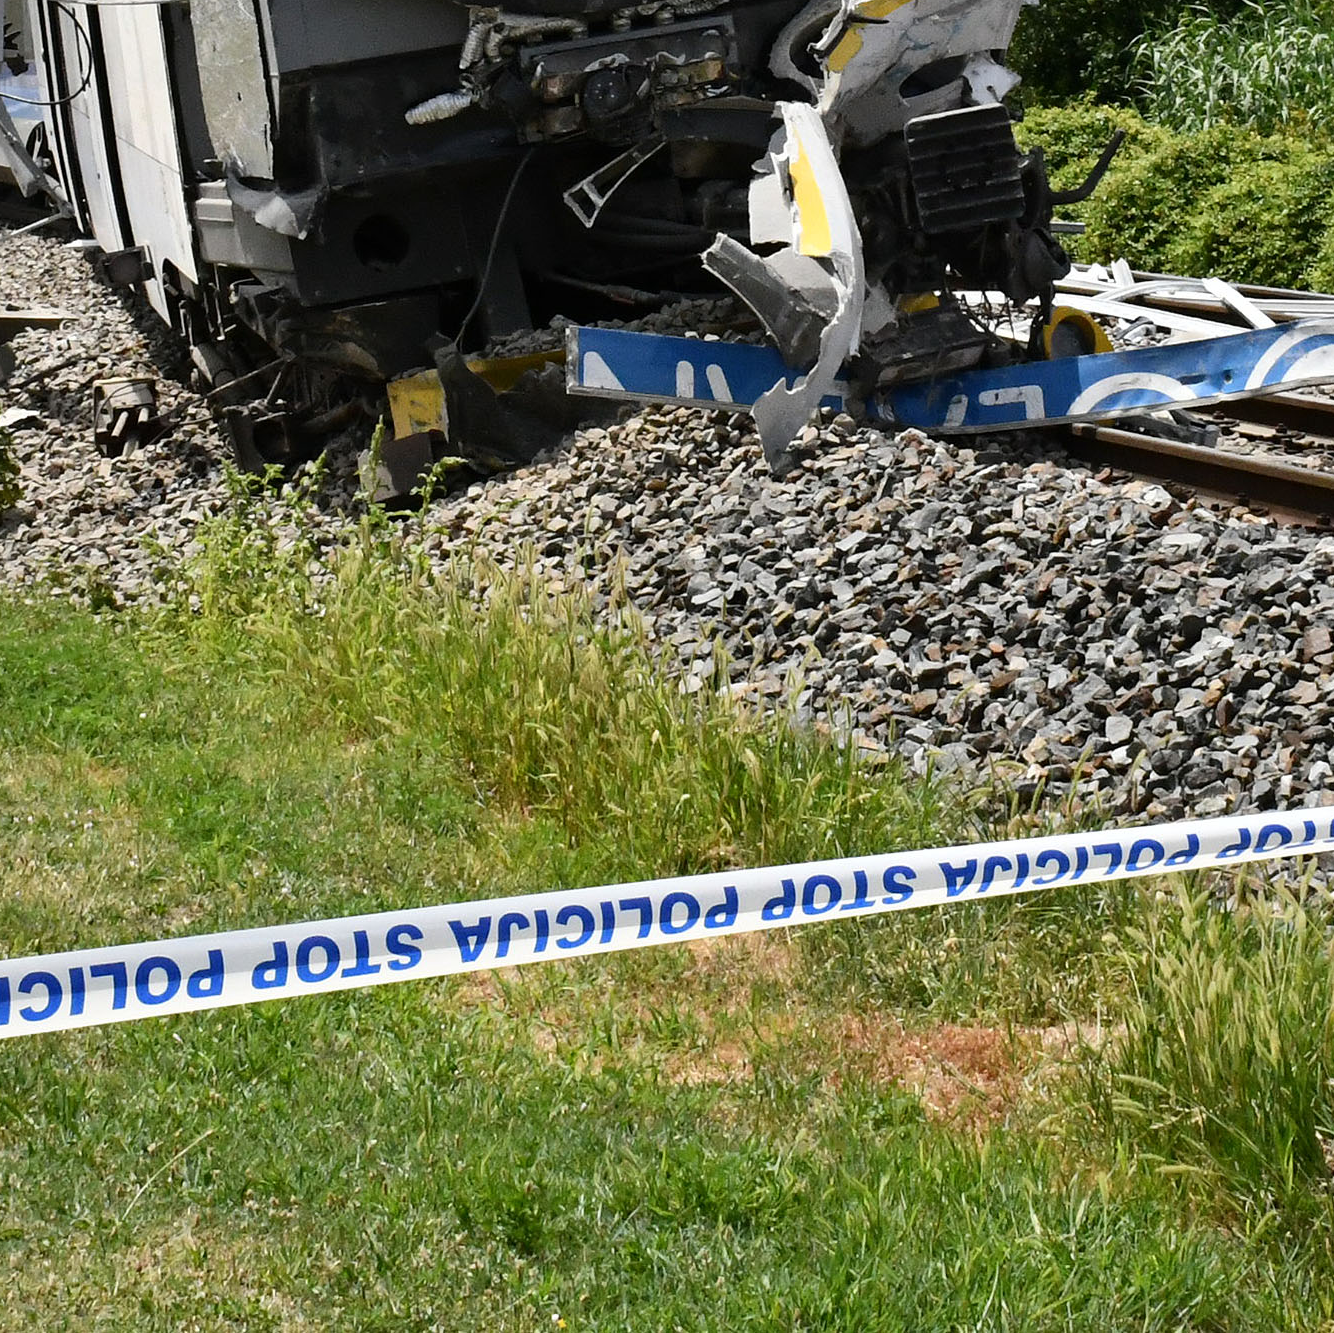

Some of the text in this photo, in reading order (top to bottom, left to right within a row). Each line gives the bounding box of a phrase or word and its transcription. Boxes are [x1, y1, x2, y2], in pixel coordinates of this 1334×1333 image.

[762, 865, 917, 921] STOP
[939, 834, 1200, 897] POLICIJA
[448, 886, 739, 963] POLICIJA
[252, 924, 423, 990] STOP
